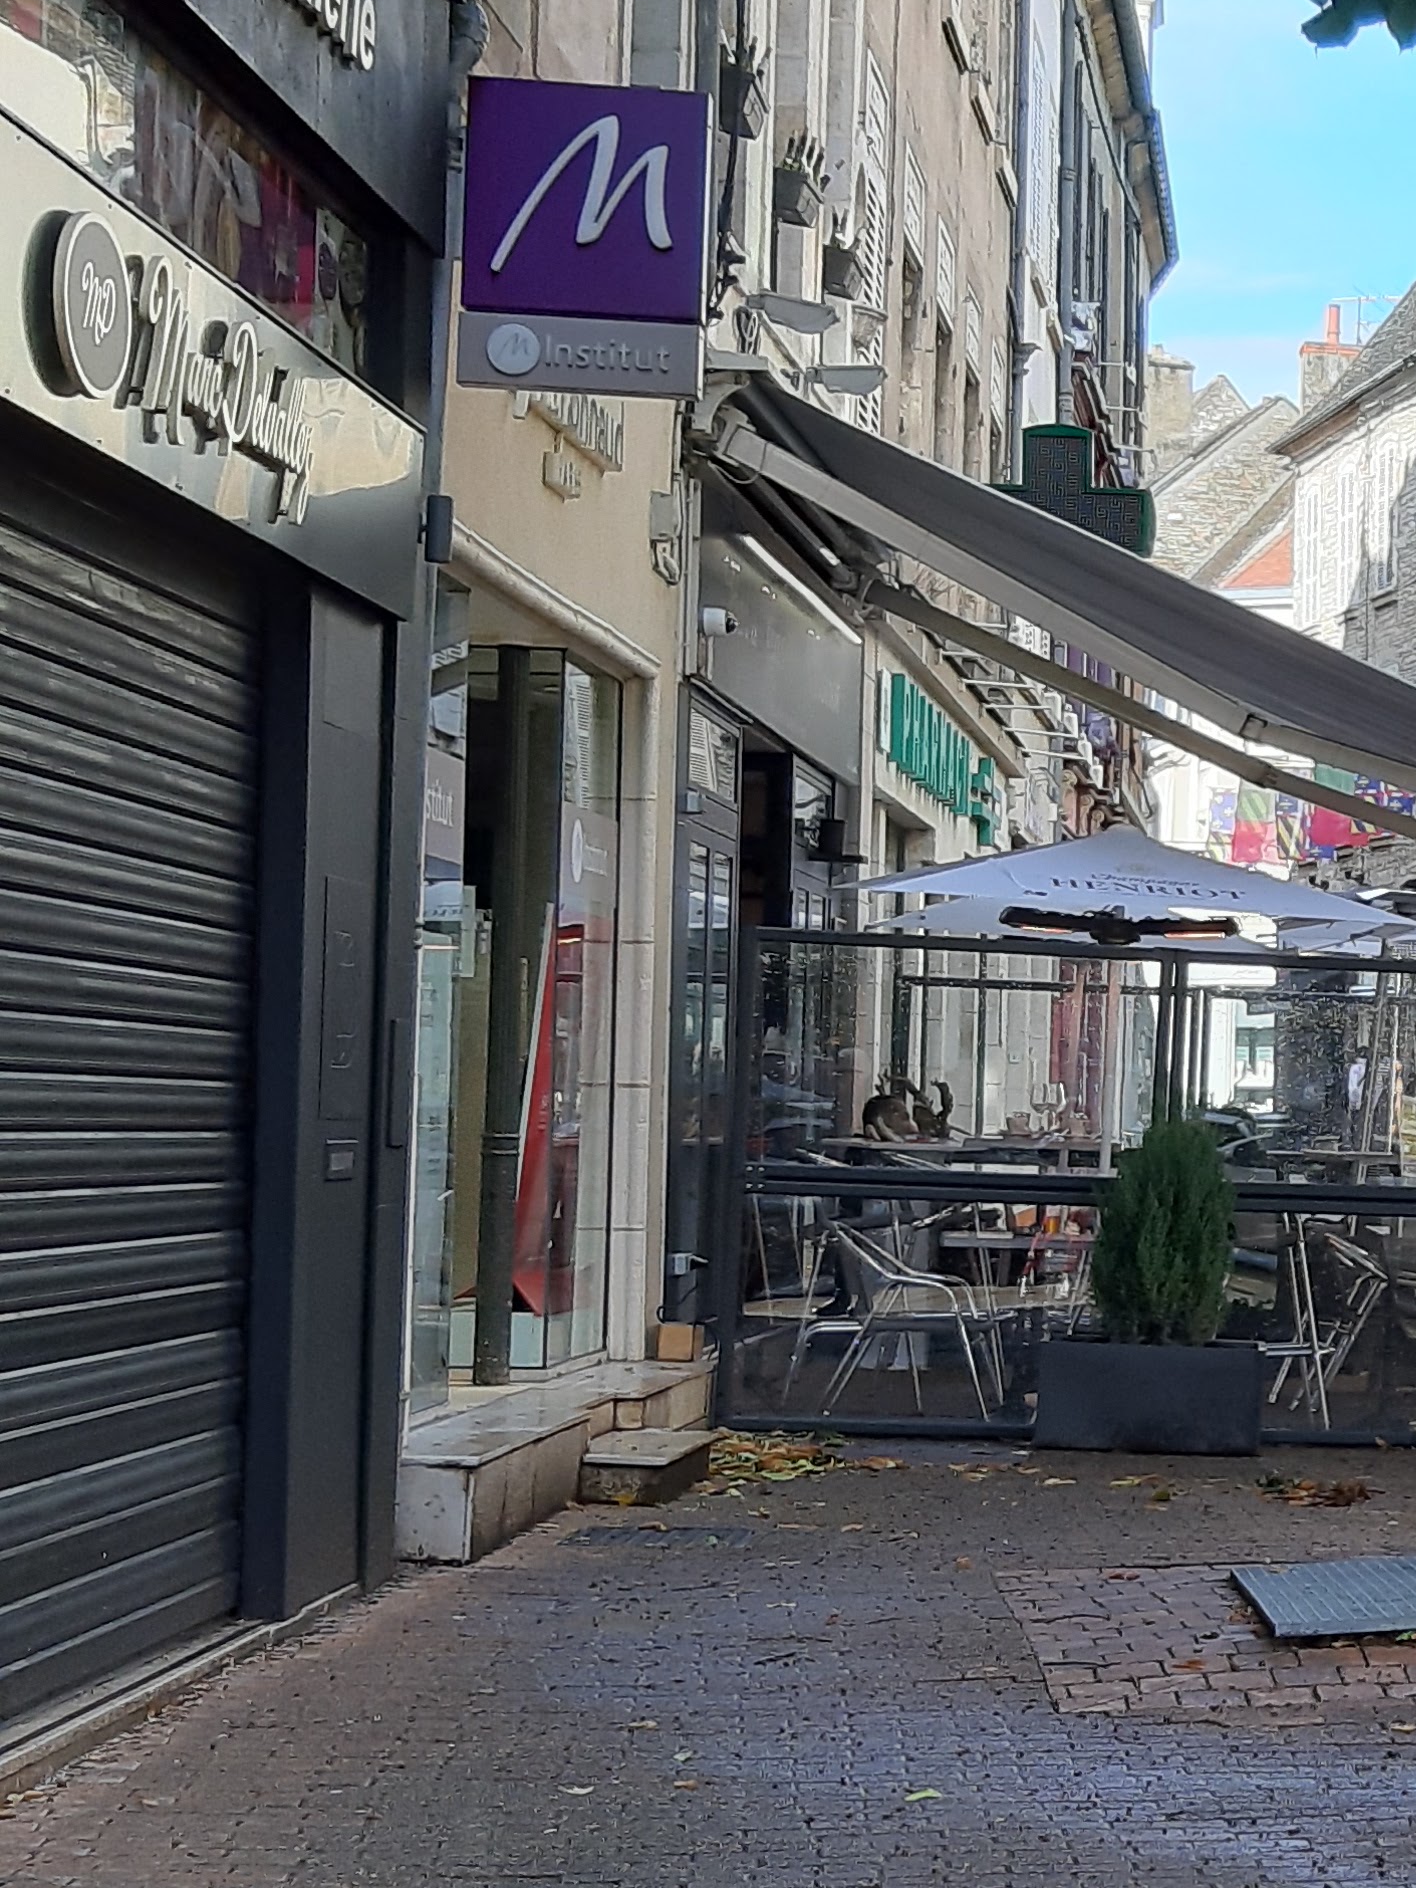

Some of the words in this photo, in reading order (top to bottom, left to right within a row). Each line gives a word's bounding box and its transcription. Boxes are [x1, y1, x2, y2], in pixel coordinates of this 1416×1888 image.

[148, 255, 224, 447] Marc
[545, 335, 671, 374] Institut
[1052, 876, 1247, 900] HENRIOT
